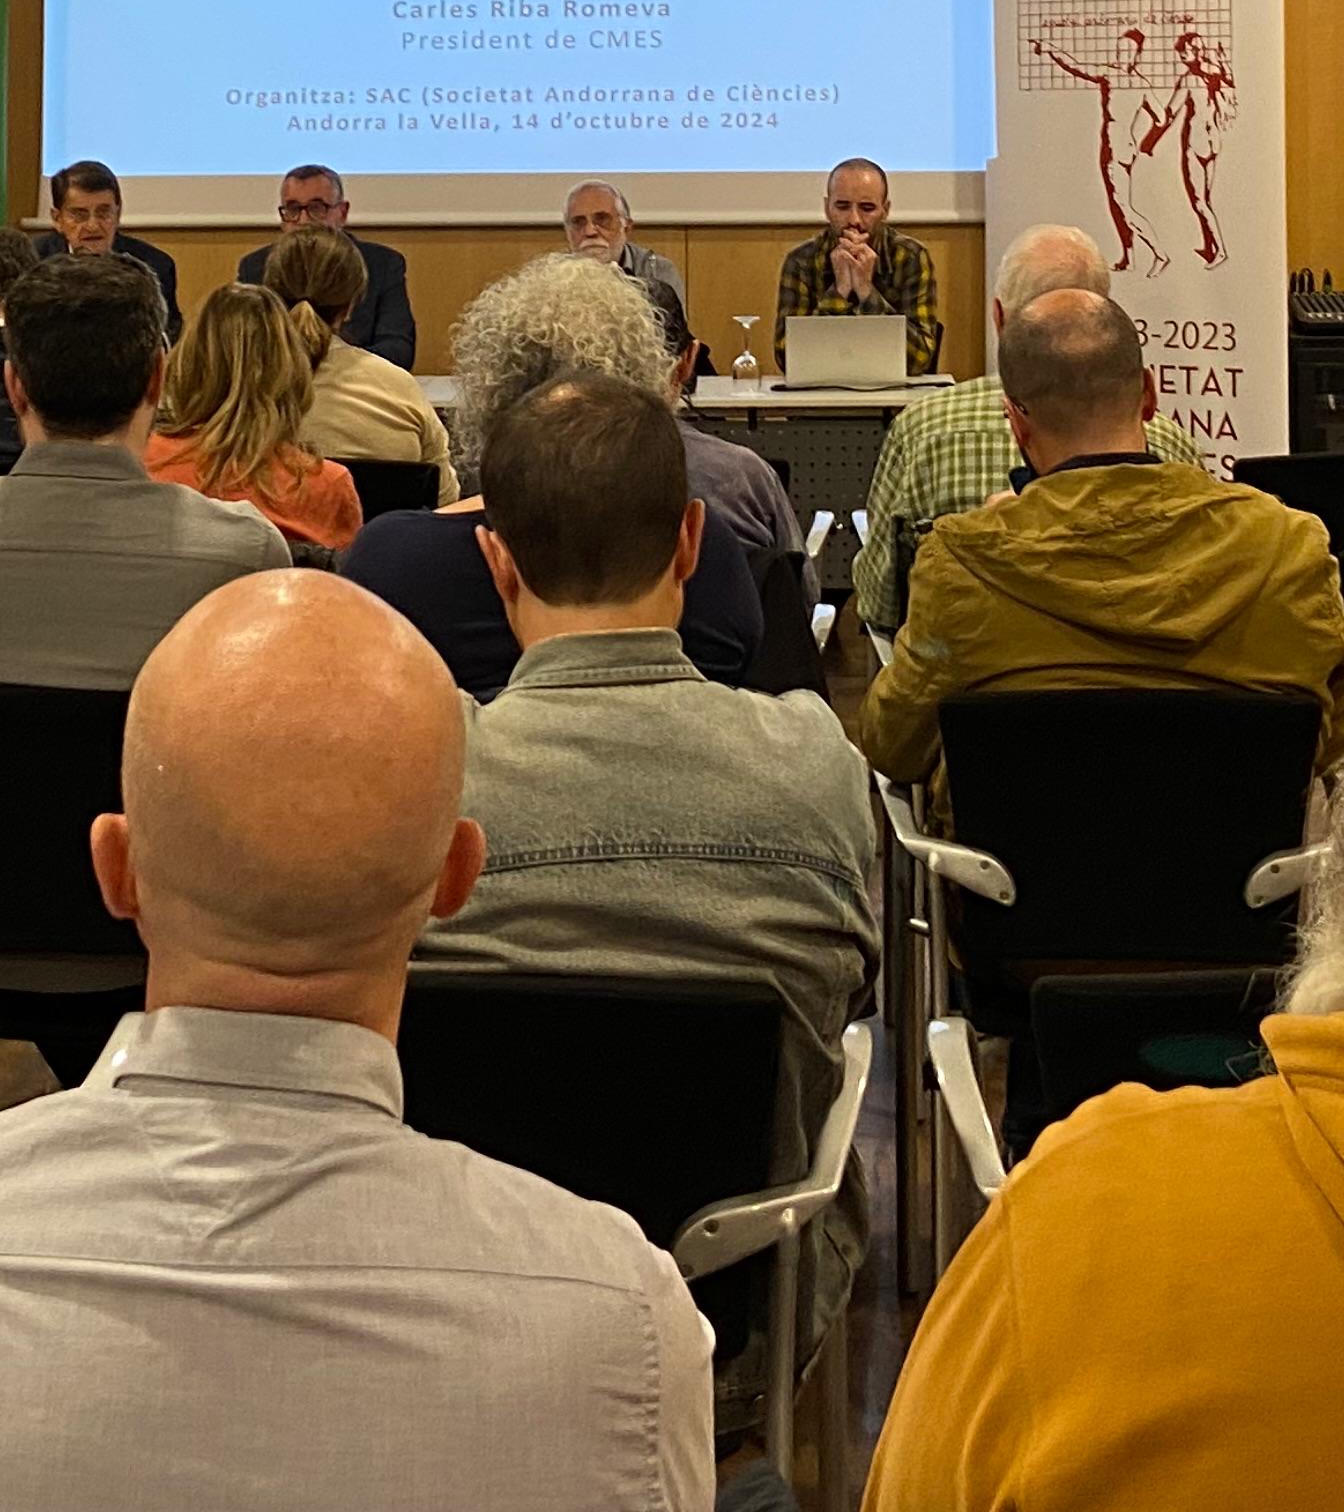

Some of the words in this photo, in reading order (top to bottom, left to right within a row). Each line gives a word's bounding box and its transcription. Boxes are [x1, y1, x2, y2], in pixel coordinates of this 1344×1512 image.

[392, 0, 478, 19] Carles
[490, 0, 550, 18] Riba
[563, 0, 670, 18] Romeva
[402, 30, 533, 50] President
[544, 30, 577, 50] de
[588, 30, 663, 49] CMES
[225, 88, 355, 109] Organitza:
[365, 87, 411, 104] SAC
[421, 86, 533, 107] (Societat
[544, 85, 675, 103] Andorrana
[687, 85, 715, 102] de
[726, 84, 839, 105] Ciències)
[287, 114, 386, 131] Andorra
[398, 114, 418, 130] la
[429, 112, 500, 133] Vella,
[512, 113, 539, 130] 14
[680, 112, 709, 129] de
[720, 112, 778, 129] 2024
[1134, 319, 1236, 351] 3-2023
